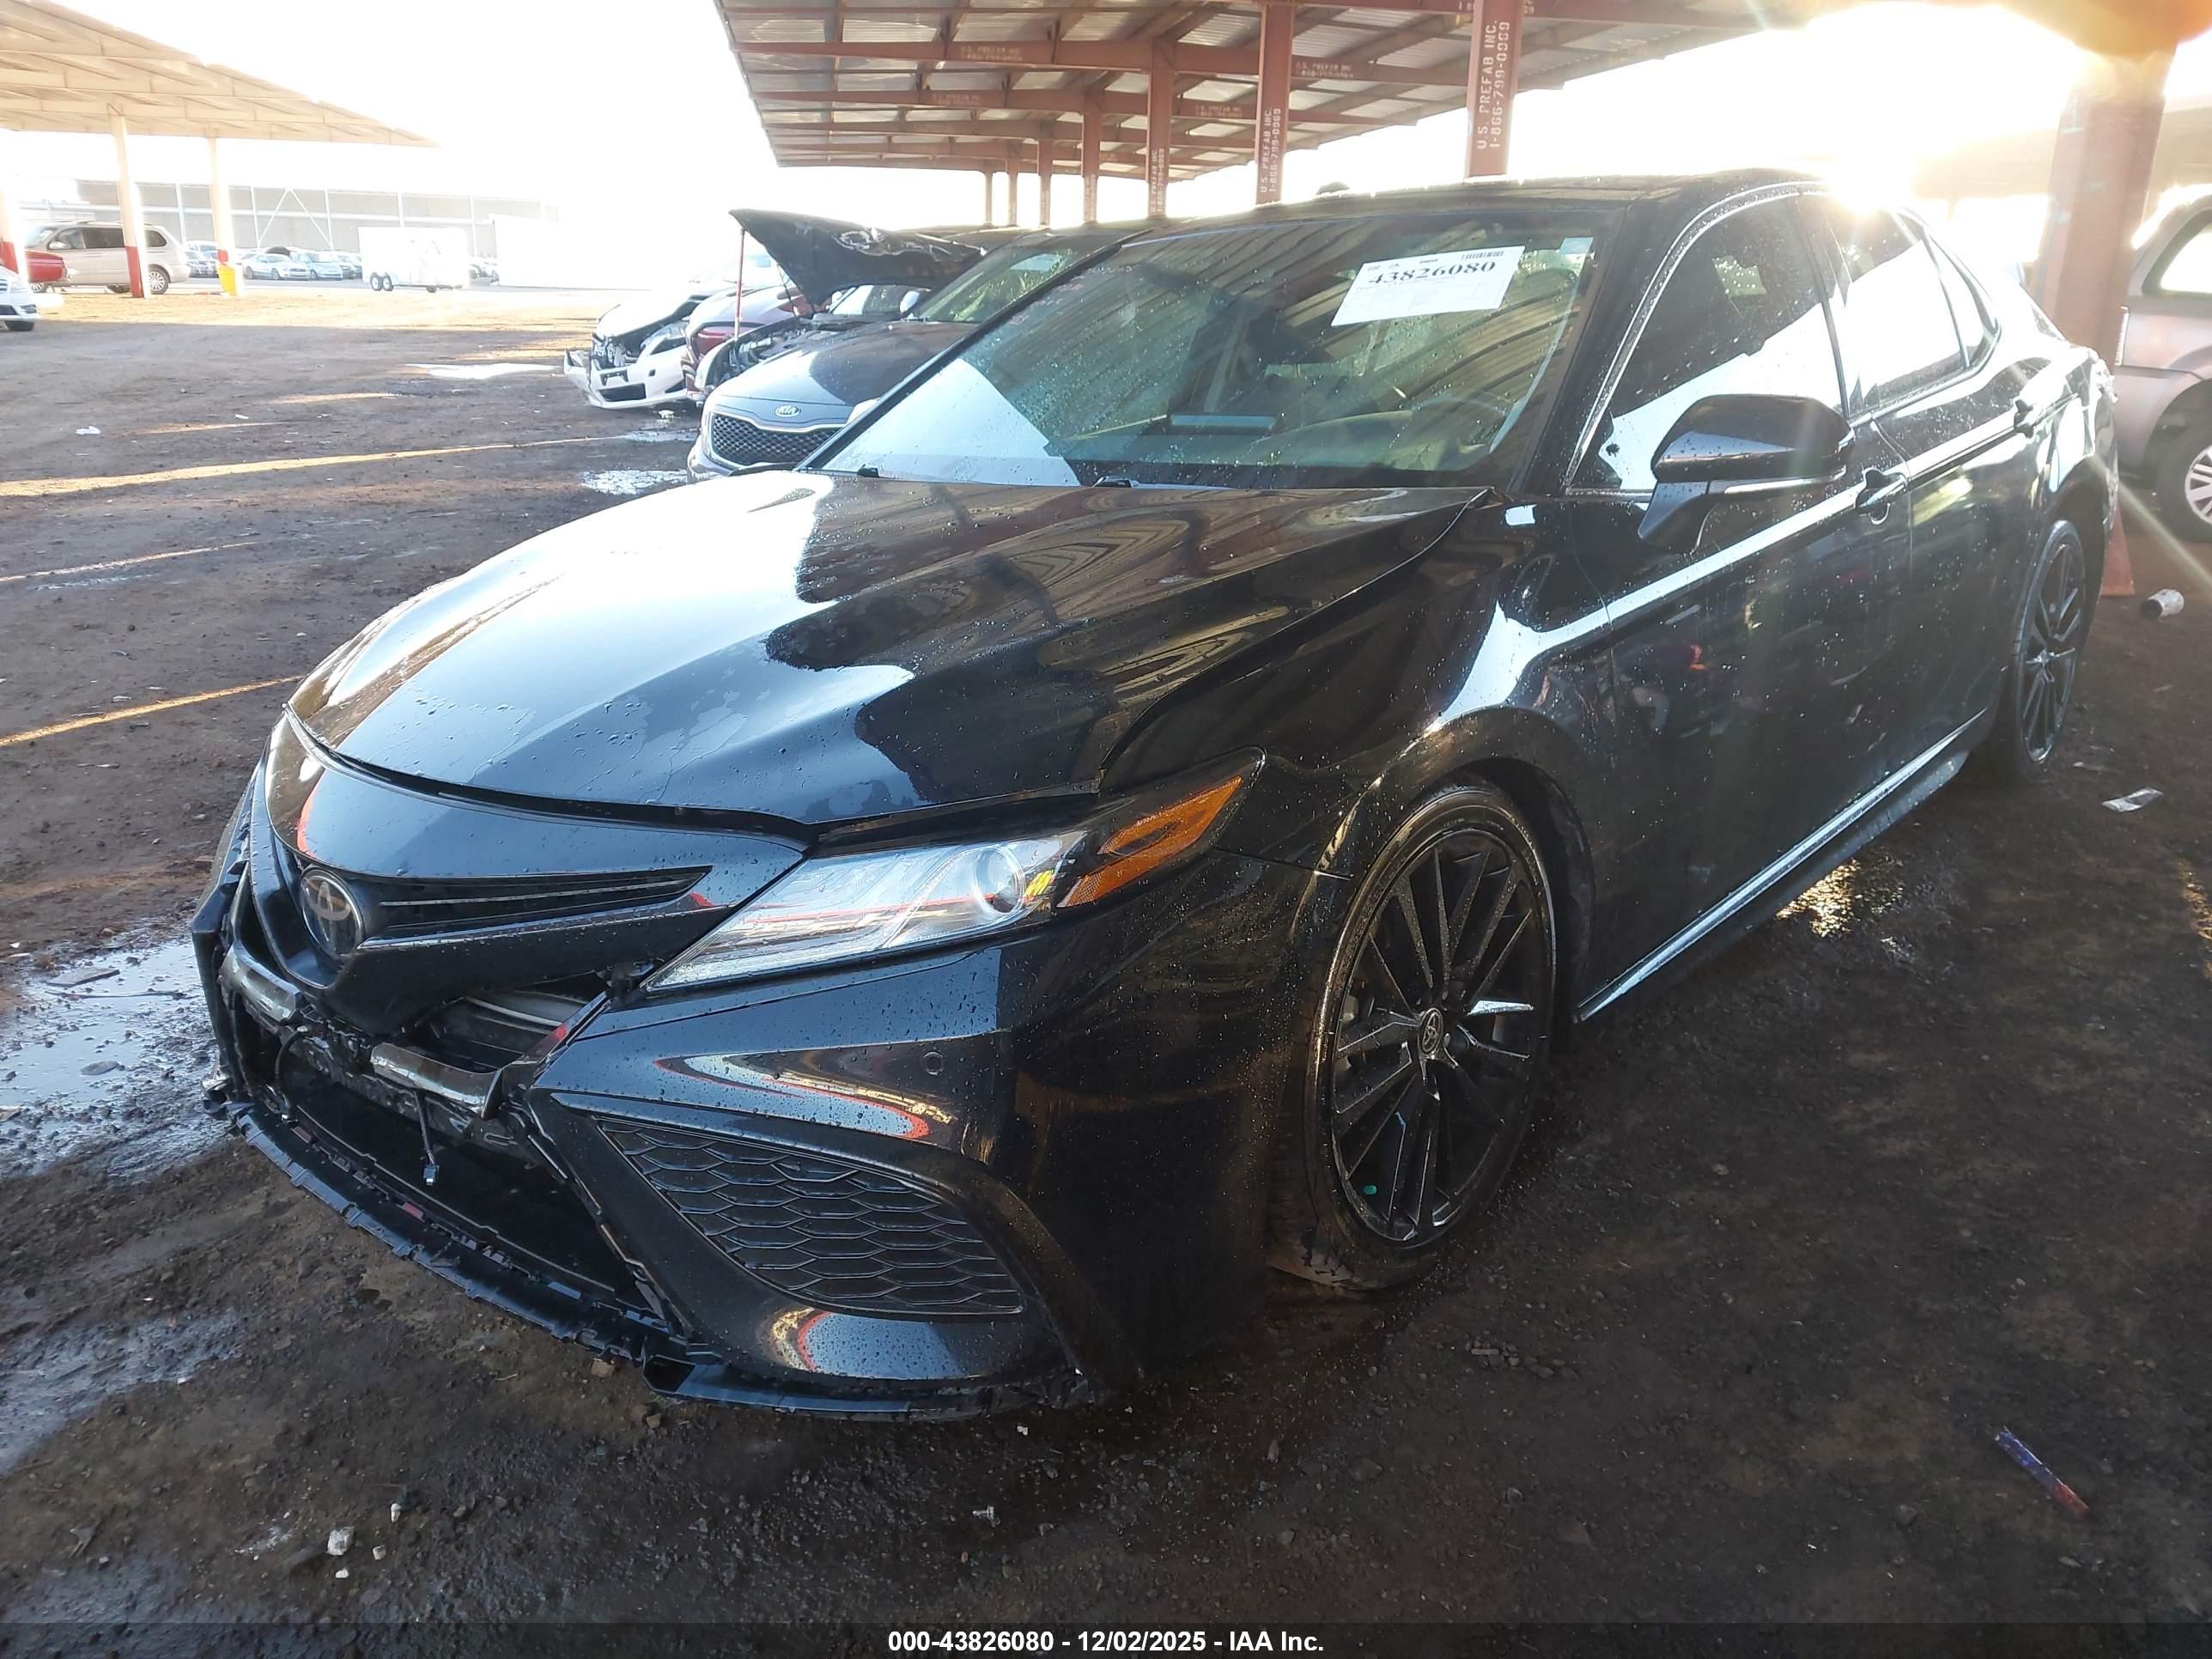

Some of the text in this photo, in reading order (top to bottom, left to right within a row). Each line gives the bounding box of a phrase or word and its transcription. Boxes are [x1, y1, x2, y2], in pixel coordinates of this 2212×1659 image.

[1484, 20, 1498, 48] INC.
[1479, 56, 1494, 113] PREFAB
[1261, 131, 1272, 169] PREFAB
[1368, 260, 1496, 284] 43826080
